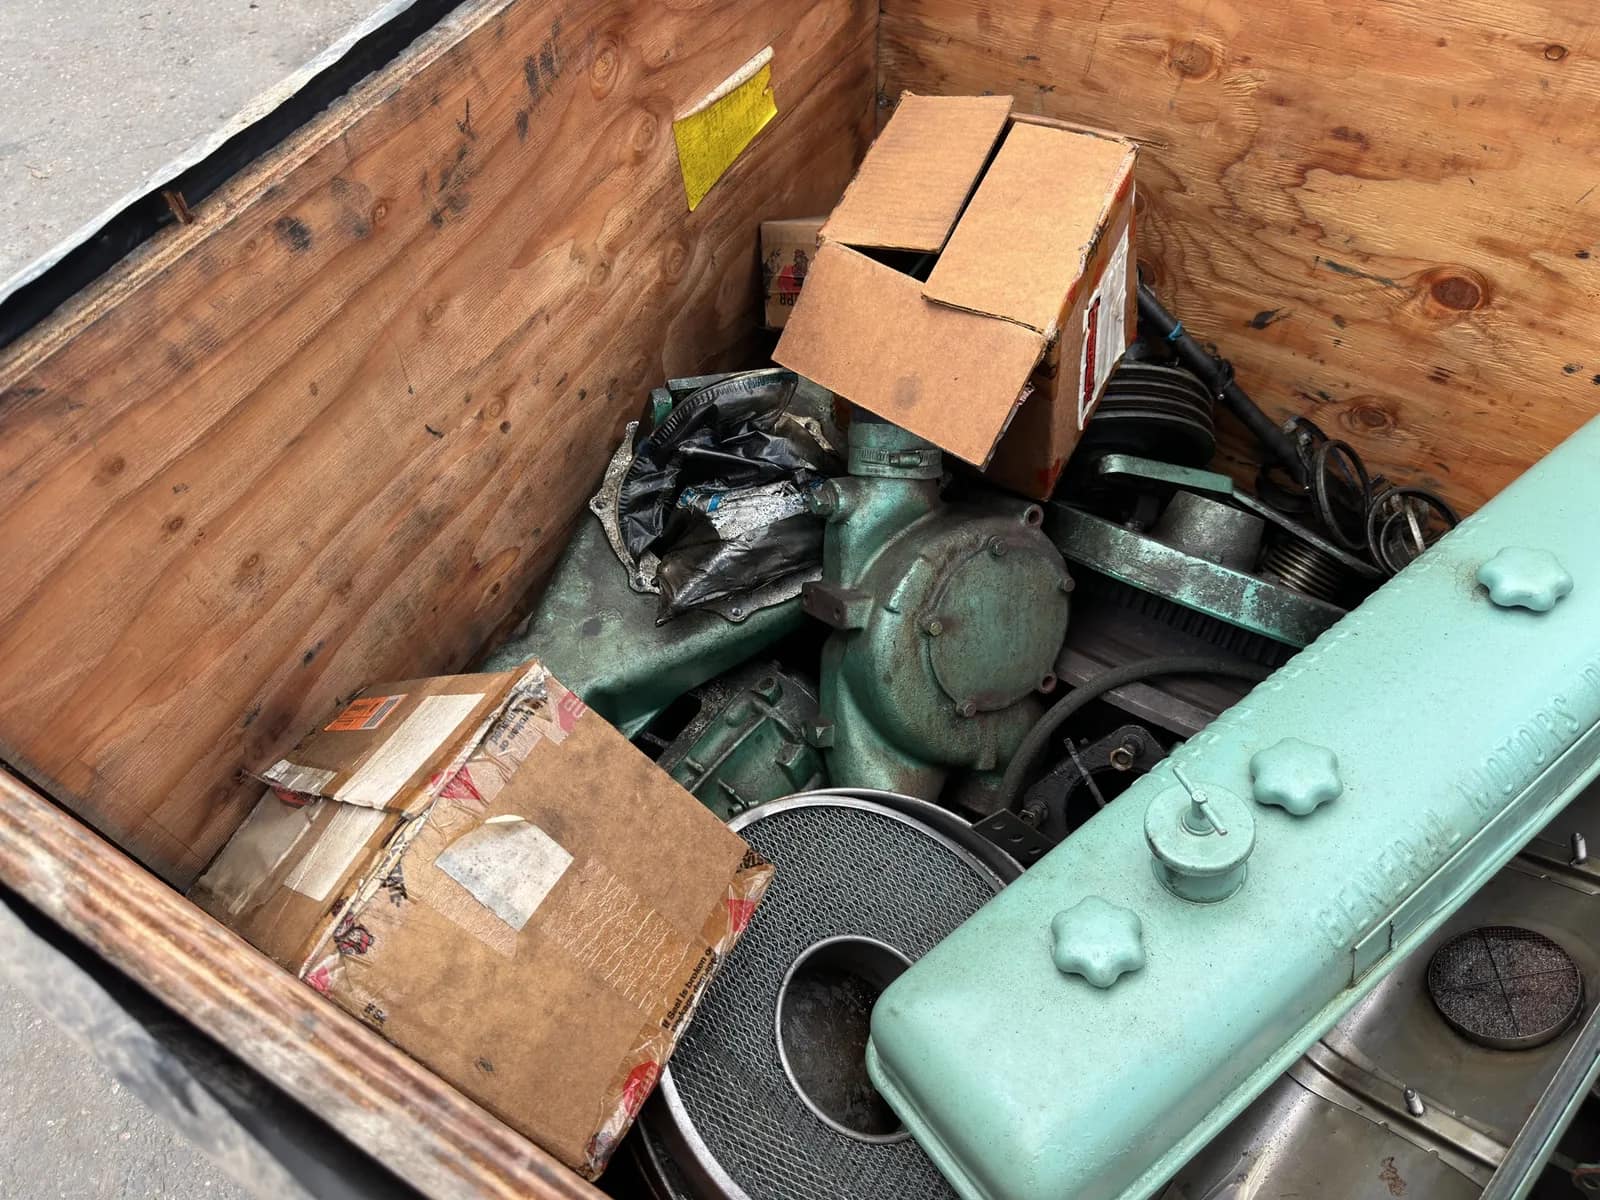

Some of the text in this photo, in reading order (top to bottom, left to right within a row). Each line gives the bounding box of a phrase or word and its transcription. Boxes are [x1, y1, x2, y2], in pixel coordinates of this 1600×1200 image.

[1317, 695, 1580, 948] GENERAL MOTORS
[685, 956, 708, 988] broken
